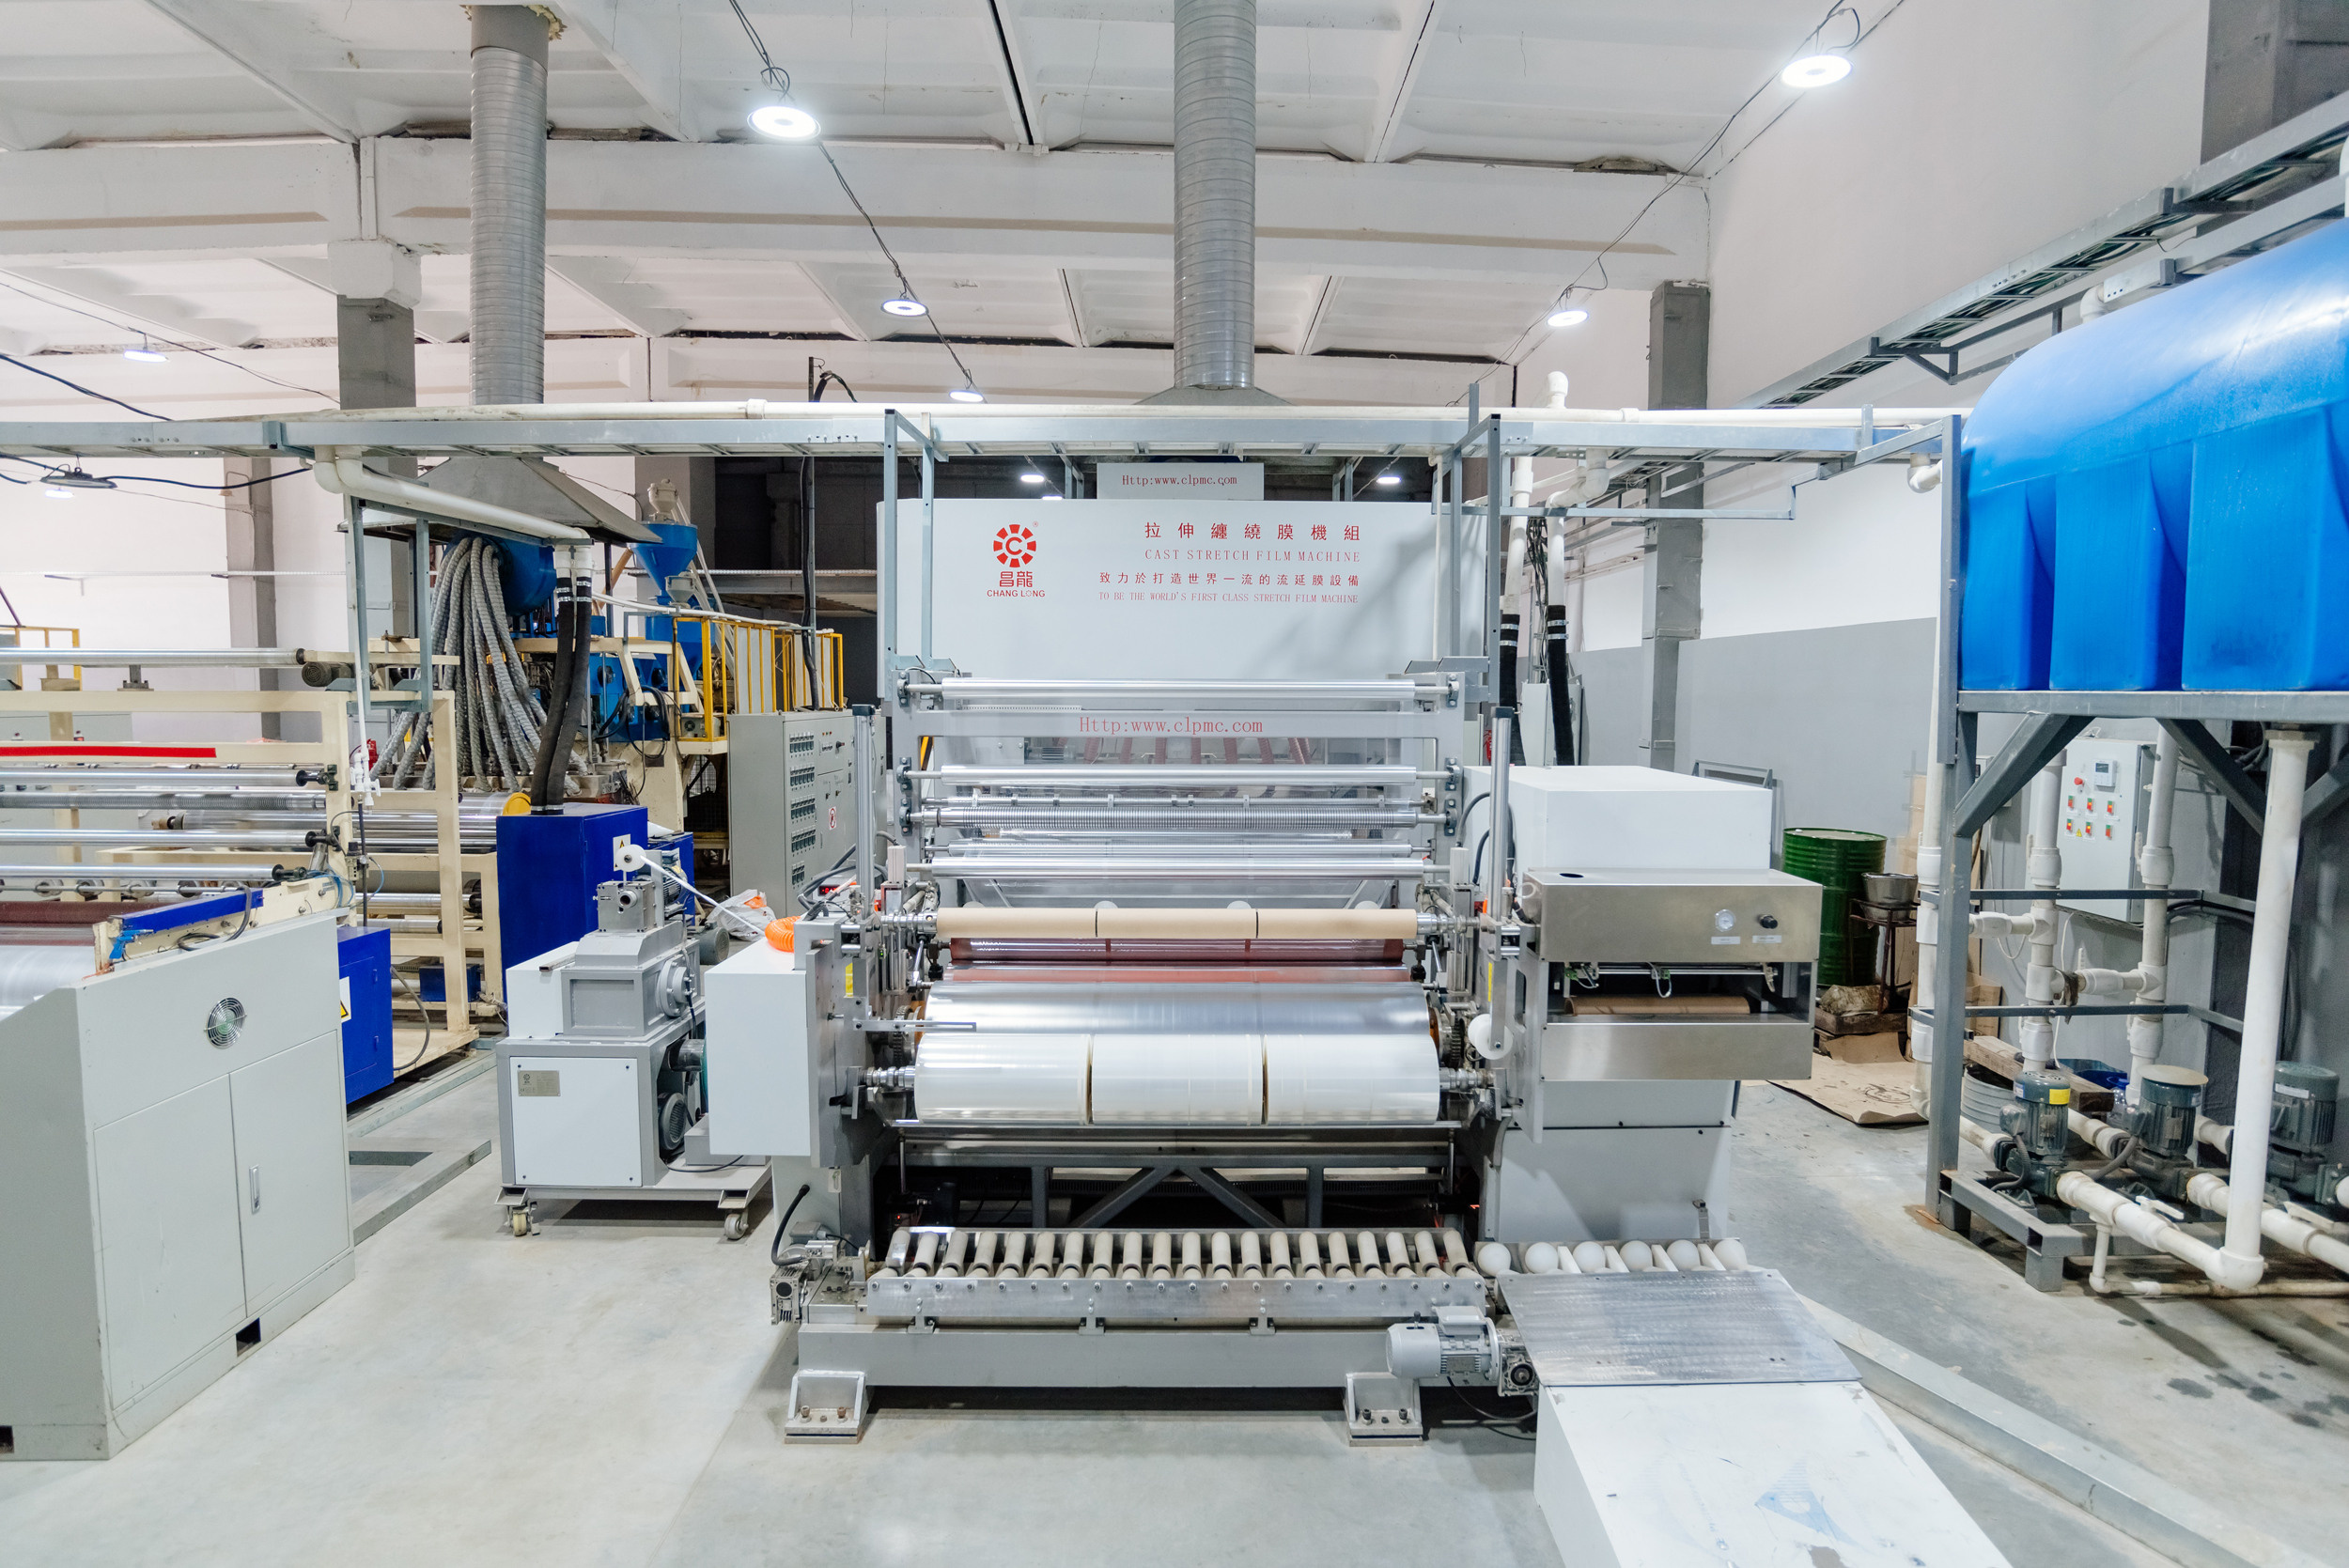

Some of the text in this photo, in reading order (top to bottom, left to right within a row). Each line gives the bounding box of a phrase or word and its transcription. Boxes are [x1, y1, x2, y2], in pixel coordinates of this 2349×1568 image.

[1122, 474, 1237, 487] Http:www.clpmc.com
[1144, 521, 1360, 541] 拉伸纏繞膜機組
[1144, 550, 1360, 562] CAST STRETCH FILM MACHINE
[999, 570, 1034, 588] 昌龍
[1099, 571, 1359, 587] 致力於打造世界一流的流延膜設備
[987, 589, 1046, 598] CHANG LONG
[1098, 591, 1359, 603] TO BE THE WORLD'S FIRST CLASS STRETCH FILM MACHINE
[1080, 717, 1263, 735] Http:www.clpmc.com
